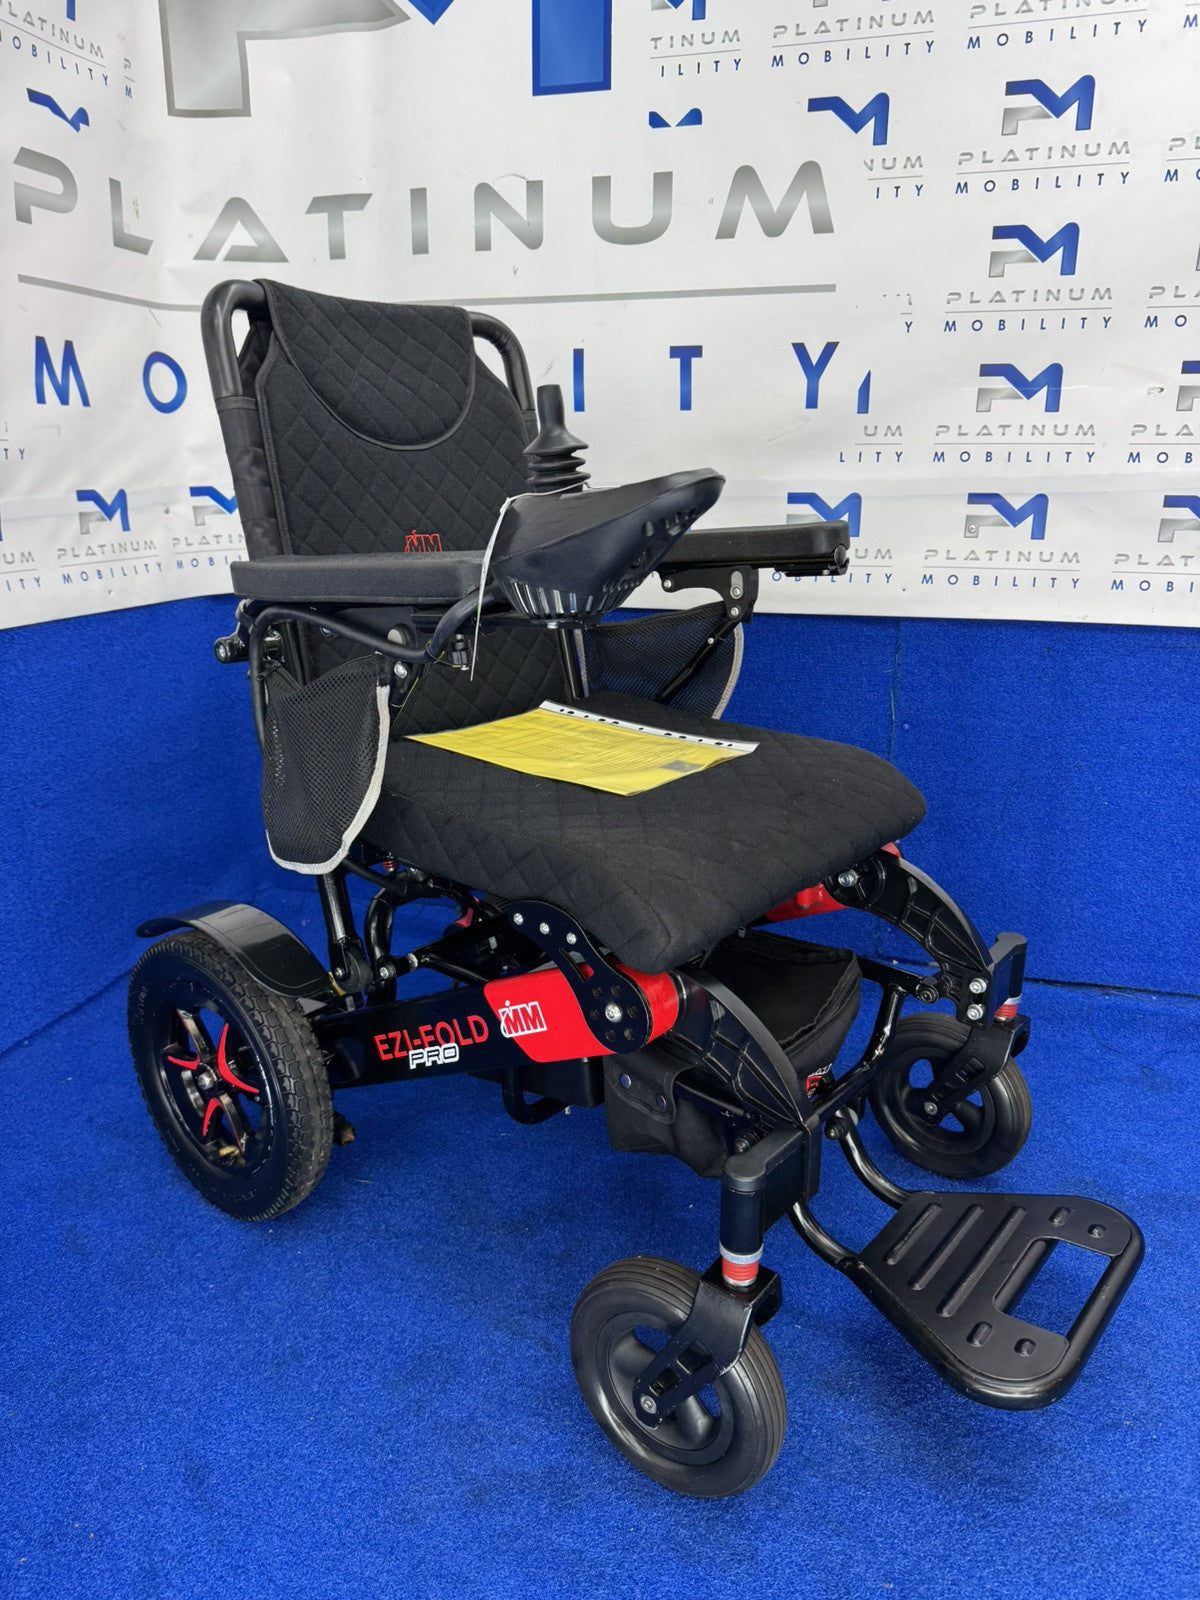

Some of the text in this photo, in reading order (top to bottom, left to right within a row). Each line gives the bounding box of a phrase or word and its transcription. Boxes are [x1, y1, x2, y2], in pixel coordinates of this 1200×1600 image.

[970, 0, 1148, 18] PLATIN
[773, 10, 934, 39] PLATINUM
[967, 19, 1147, 49] MOBILITY
[0, 28, 108, 86] OBILITY
[771, 40, 934, 68] MOBILITY
[958, 141, 1130, 165] PLATINUM
[955, 172, 1130, 194] MOBILITY
[13, 146, 834, 263] PLATINUM
[946, 287, 1112, 304] PLATINUM
[943, 317, 1112, 332] MOBILITY
[935, 424, 1096, 437] PLATINUM
[932, 452, 1096, 463] MOBILITY
[57, 540, 157, 560] PLATINUM
[924, 549, 1081, 564] PLATINUM
[63, 562, 163, 584] MOBILITY
[921, 574, 1080, 588] MOBILITY
[374, 1014, 489, 1061] EZI-FOLD
[409, 1043, 460, 1069] PRO
